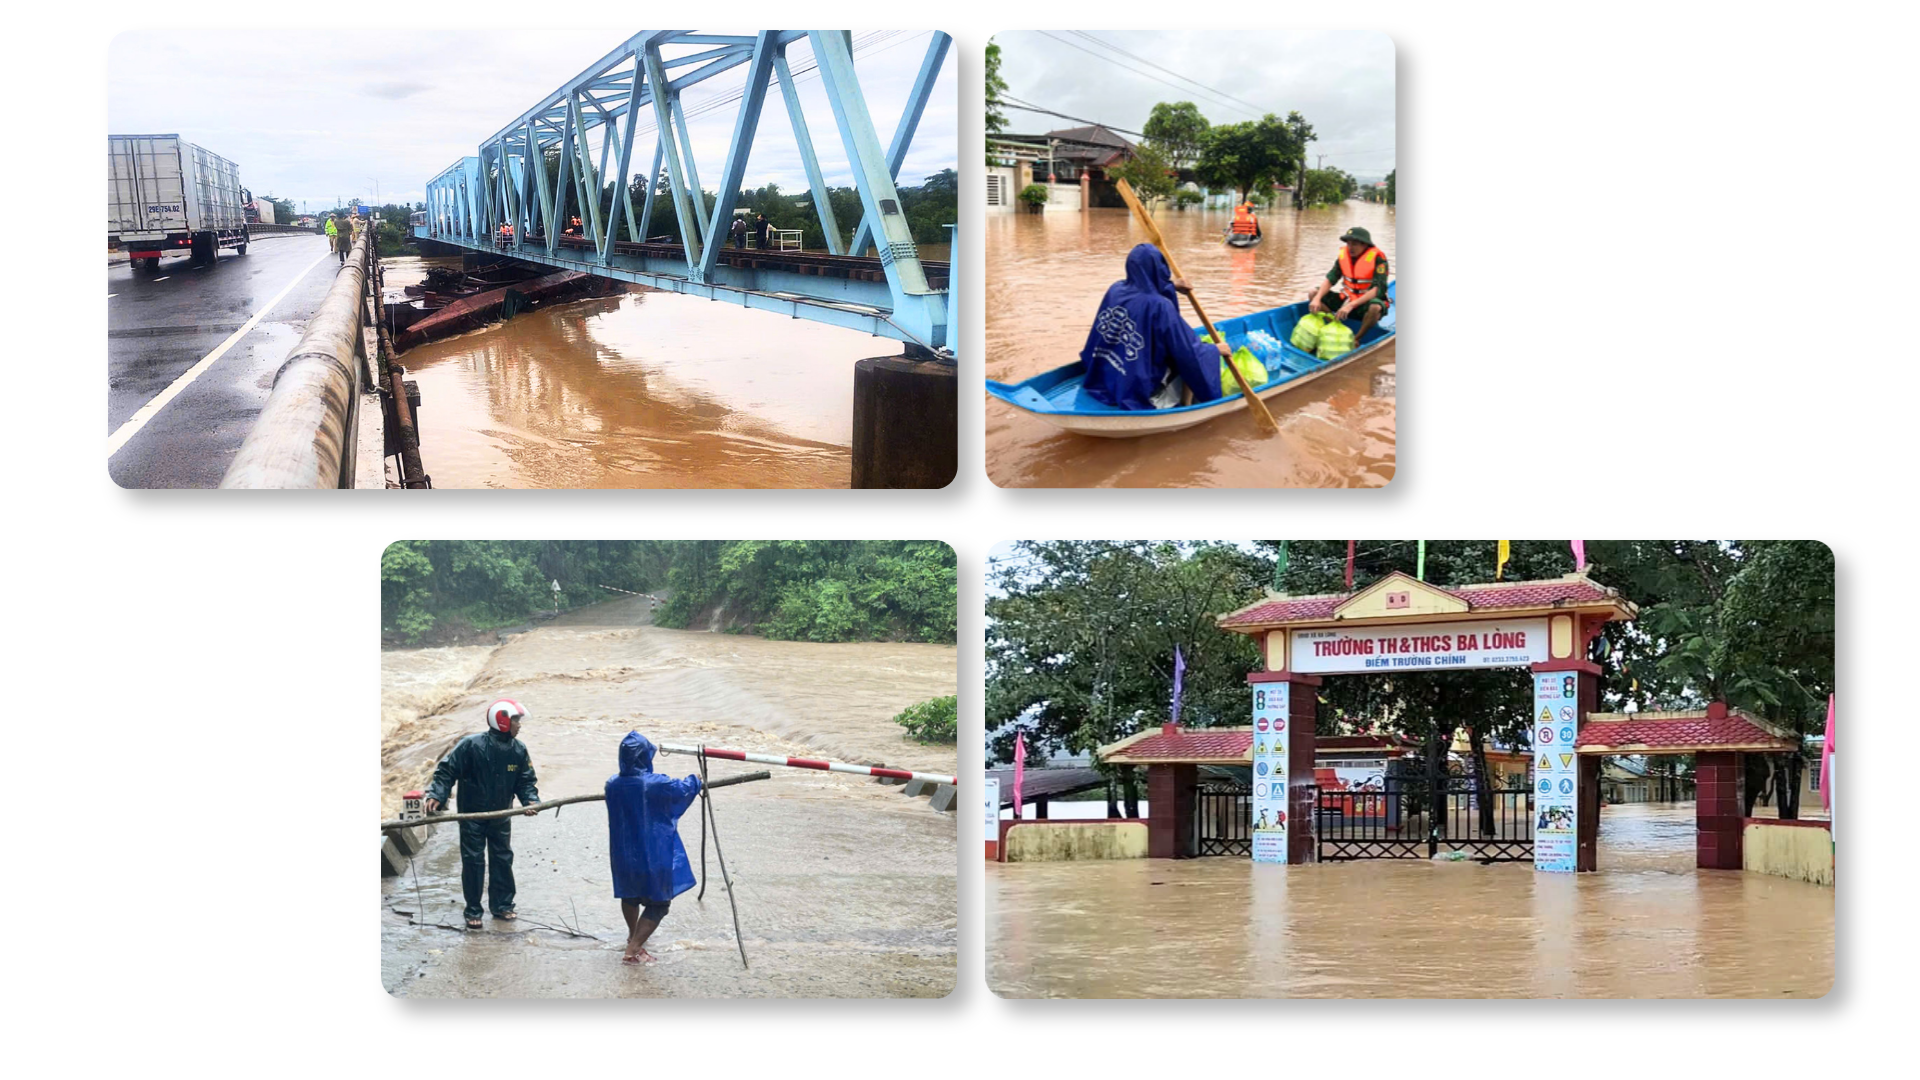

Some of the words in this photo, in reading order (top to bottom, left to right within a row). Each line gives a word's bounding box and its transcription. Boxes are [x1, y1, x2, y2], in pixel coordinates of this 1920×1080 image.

[1313, 635, 1374, 657] TRƯỜNG
[1457, 634, 1478, 651] BA
[1483, 628, 1526, 650] LÒNG
[1365, 655, 1390, 668] ĐIỂM
[1392, 654, 1432, 667] TRƯỜNG
[1434, 653, 1467, 665] CHÍNH
[1561, 730, 1572, 739] 30
[405, 799, 421, 809] H9
